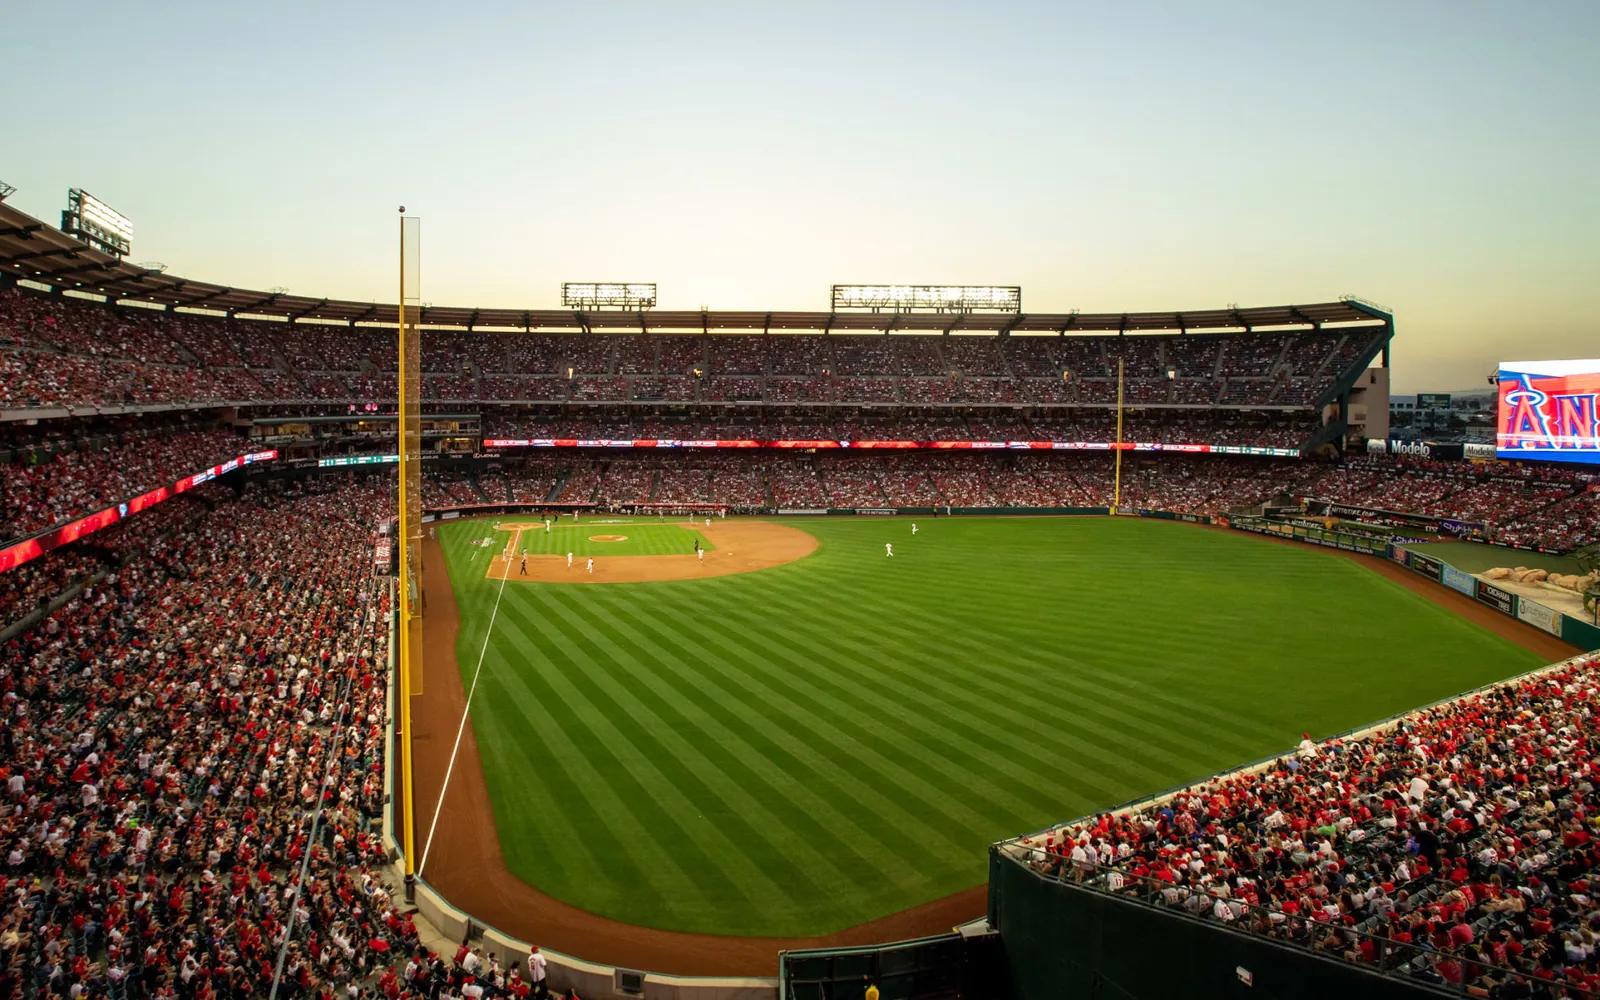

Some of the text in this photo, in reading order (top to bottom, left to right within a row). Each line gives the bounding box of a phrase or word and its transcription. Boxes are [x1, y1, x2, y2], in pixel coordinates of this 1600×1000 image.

[1391, 439, 1430, 456] Modelo
[1467, 445, 1494, 456] Modelo
[1487, 586, 1510, 602] YOKOHAMA
